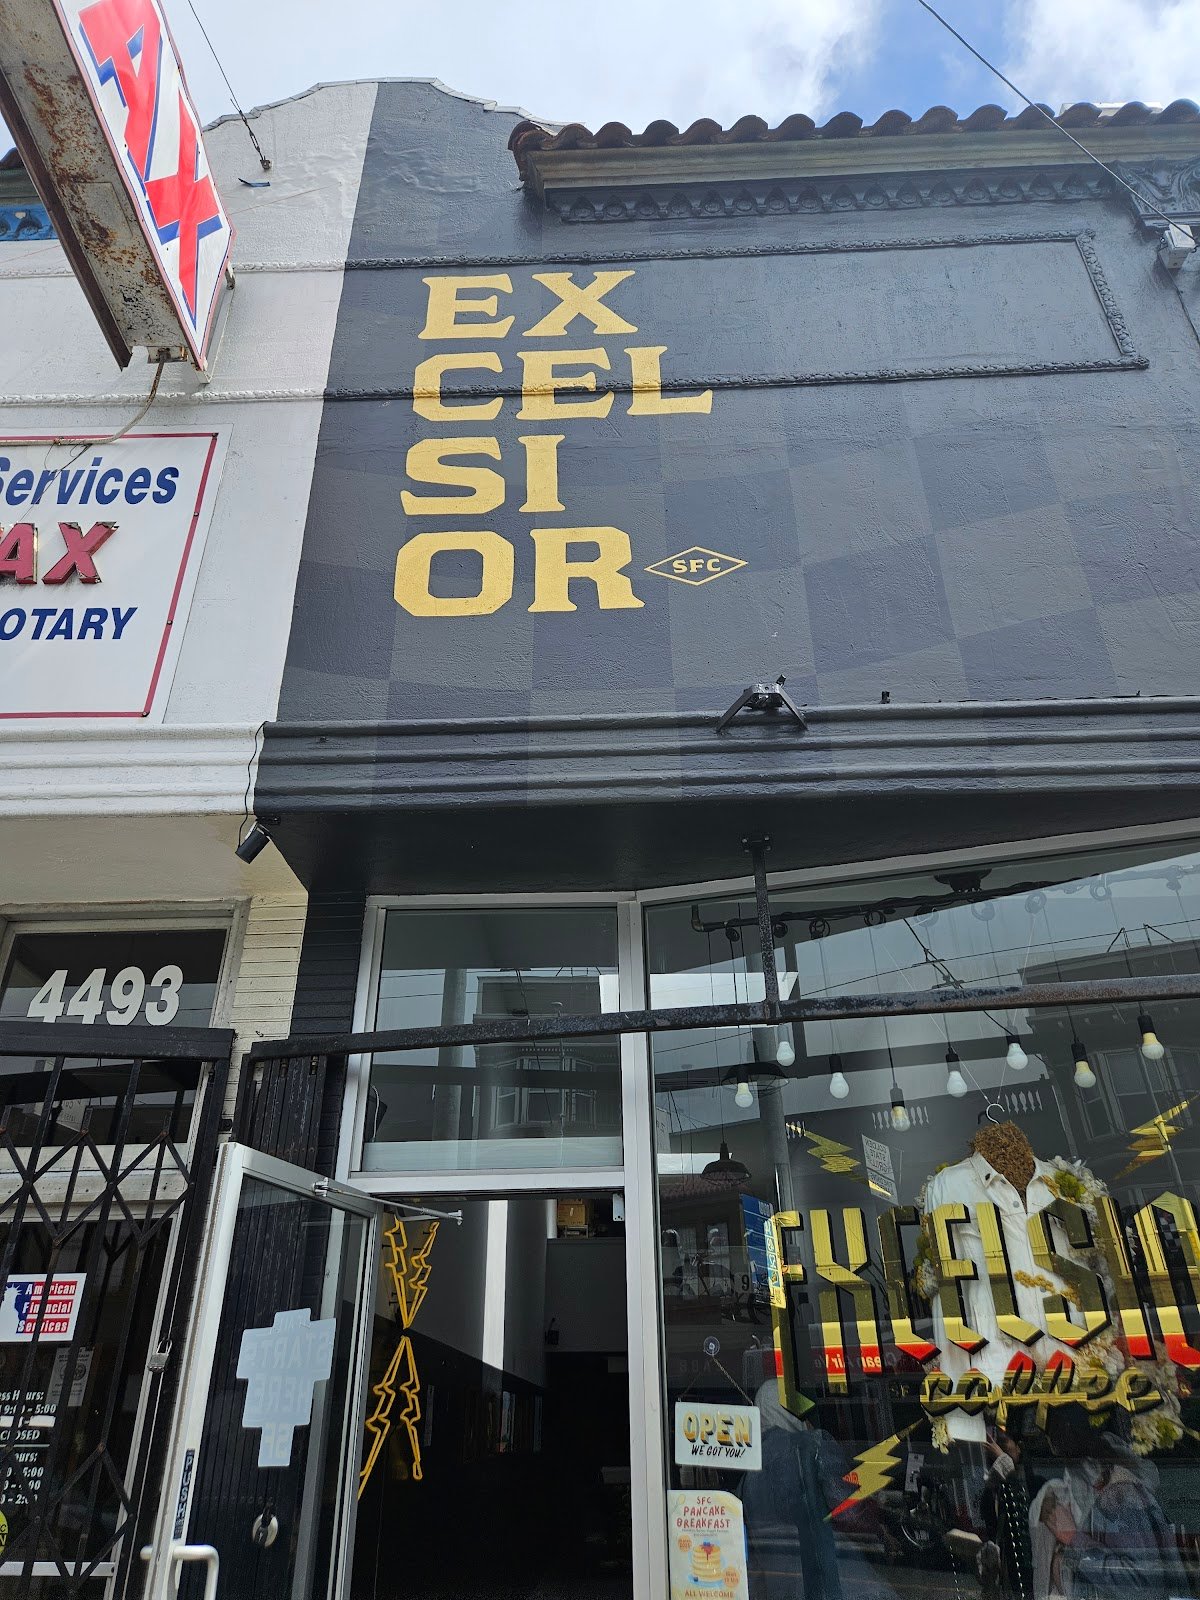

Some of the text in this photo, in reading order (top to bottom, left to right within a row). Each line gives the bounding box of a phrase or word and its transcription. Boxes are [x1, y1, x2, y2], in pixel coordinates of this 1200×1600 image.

[418, 270, 638, 339] EX
[412, 345, 713, 421] CEL
[400, 434, 566, 515] SI
[393, 526, 645, 617] OR
[672, 557, 722, 573] SFC
[26, 964, 184, 1026] 4493
[25, 1283, 76, 1295] Amrican
[22, 1301, 72, 1313] Finncial
[12, 1390, 45, 1401] Hurs:
[34, 1403, 57, 1414] 5:00
[682, 1411, 753, 1447] OPEN
[691, 1444, 747, 1459] WE GOT YOU!
[696, 1495, 712, 1505] SFC
[683, 1505, 726, 1517] PANCAKE
[676, 1517, 731, 1529] BREAKFAST
[698, 1590, 735, 1598] WELCOME
